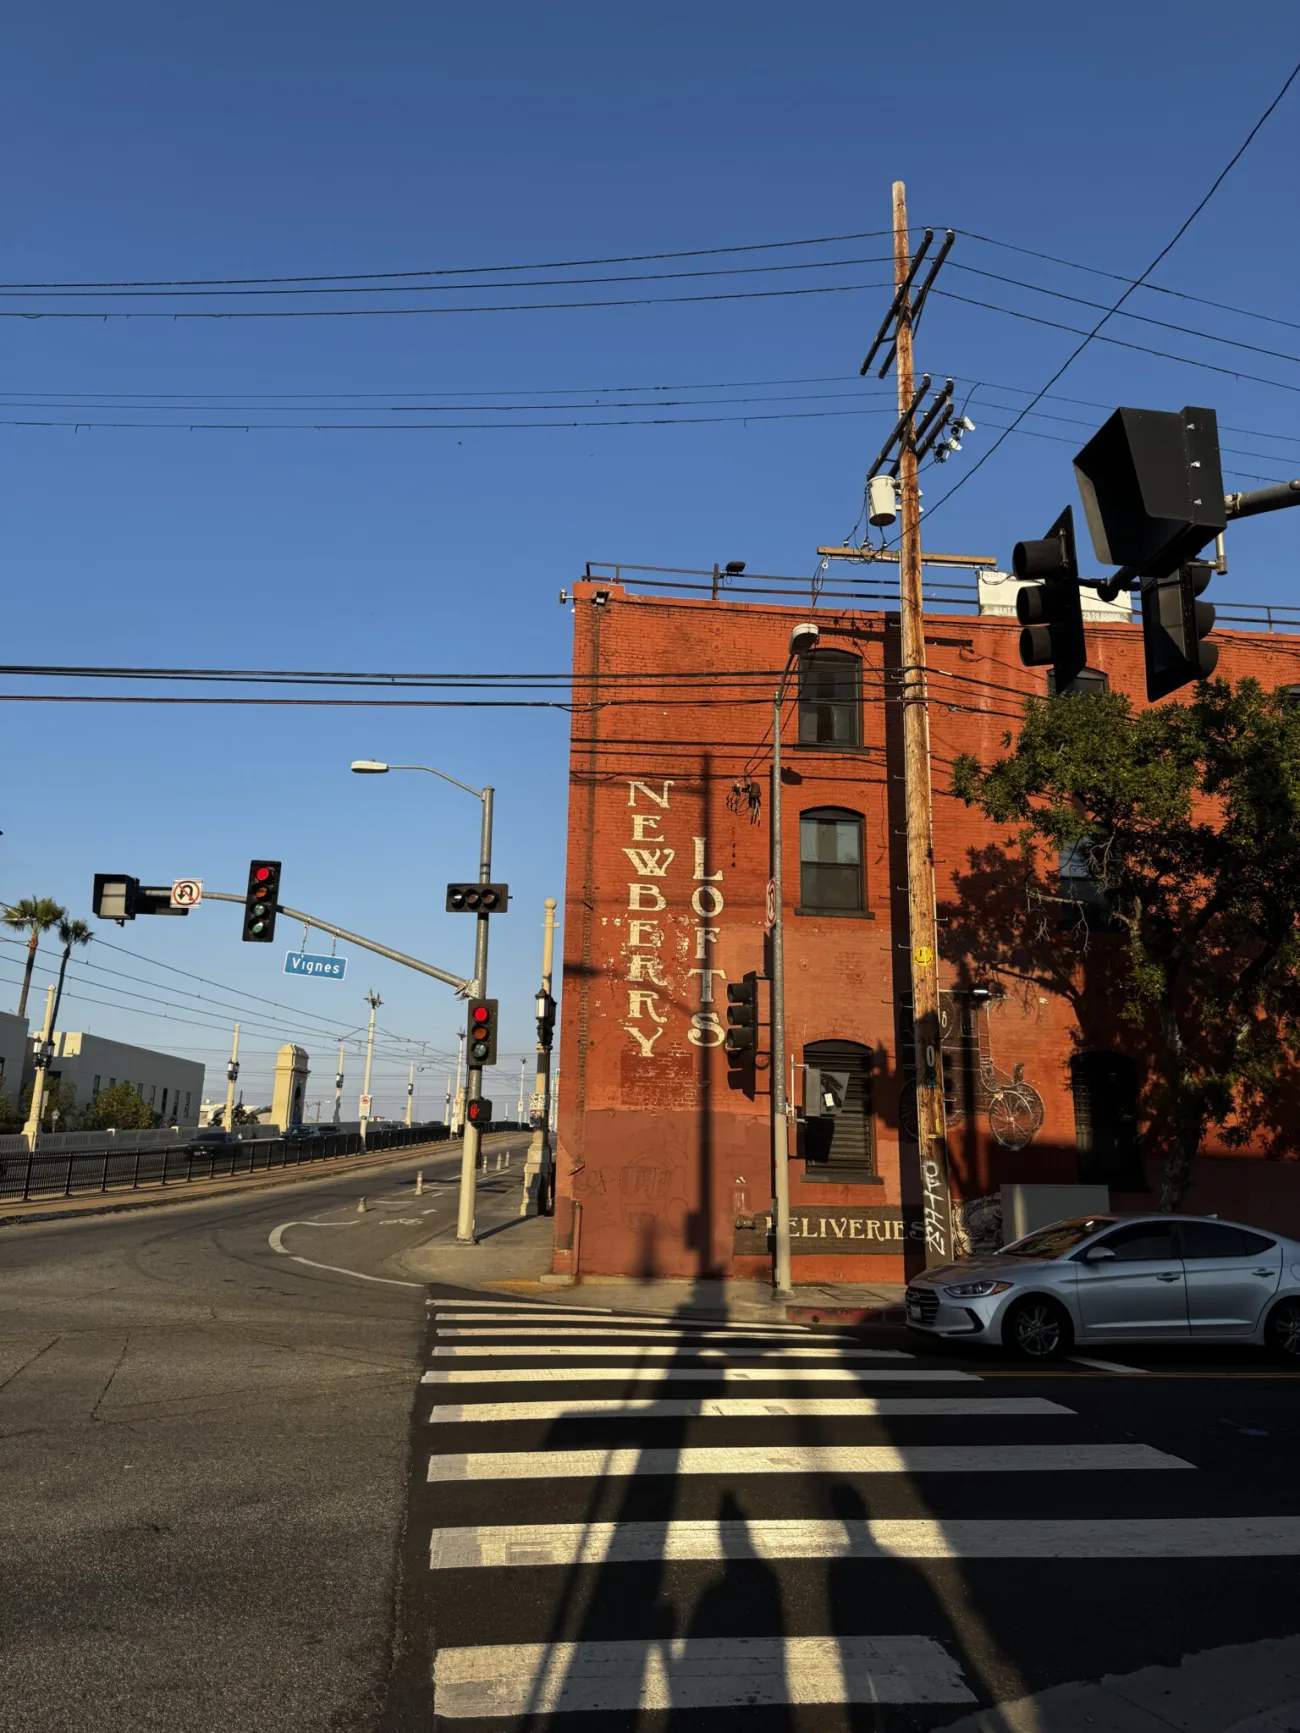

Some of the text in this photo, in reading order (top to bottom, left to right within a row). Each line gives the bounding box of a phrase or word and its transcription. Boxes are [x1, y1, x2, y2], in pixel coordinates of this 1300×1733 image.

[292, 955, 340, 974] Vignes
[622, 780, 675, 1057] NEWBERRY
[687, 836, 727, 1047] LOFTS
